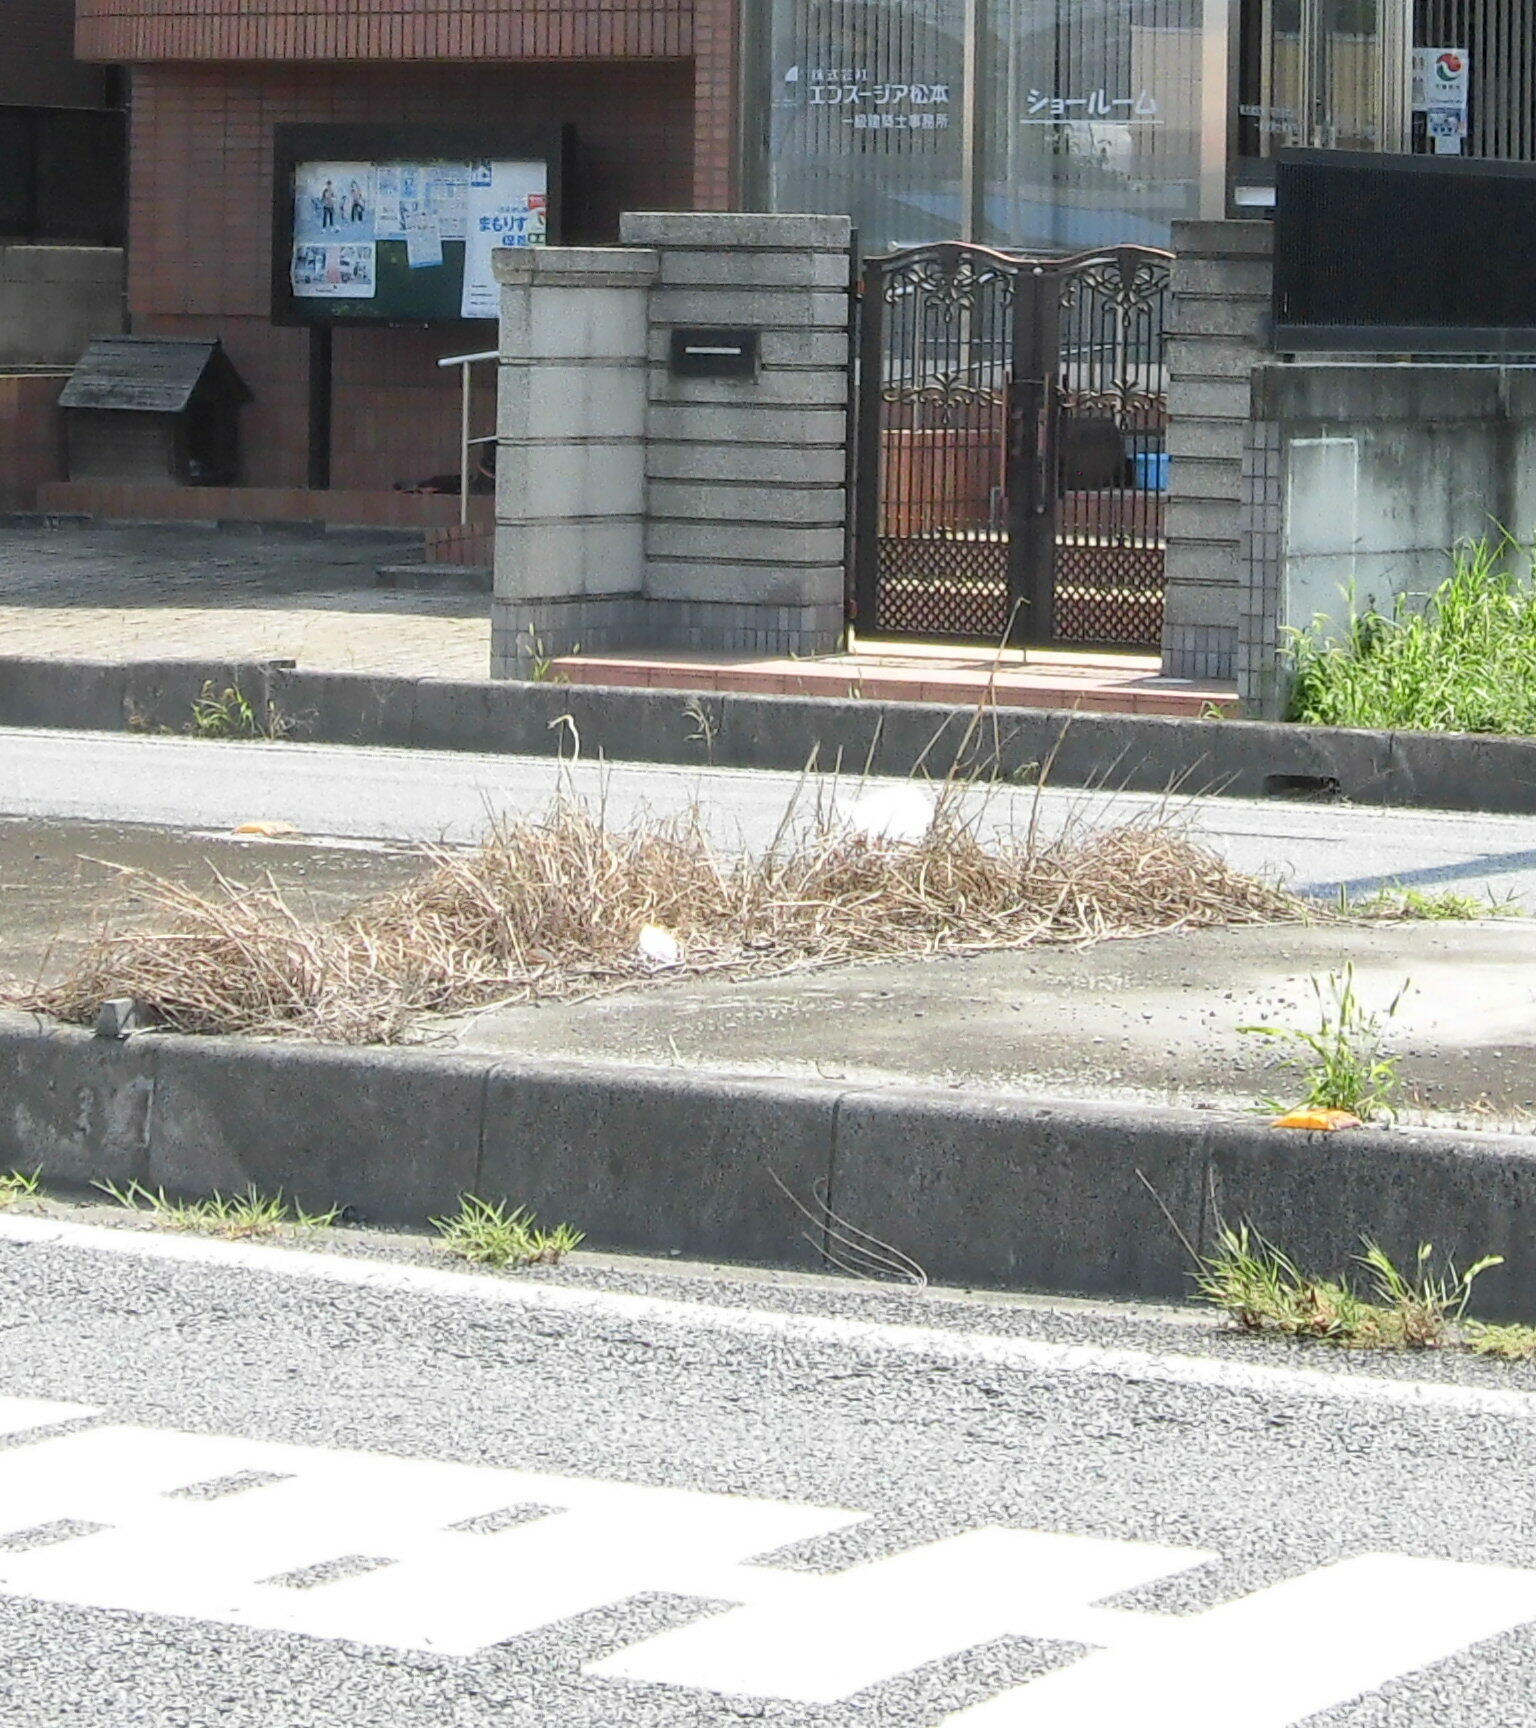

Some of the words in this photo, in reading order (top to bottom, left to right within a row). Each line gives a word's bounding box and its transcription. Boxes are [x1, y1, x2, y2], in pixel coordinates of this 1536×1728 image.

[809, 83, 949, 105] エンスージア松本
[1027, 88, 1158, 115] ショールーム
